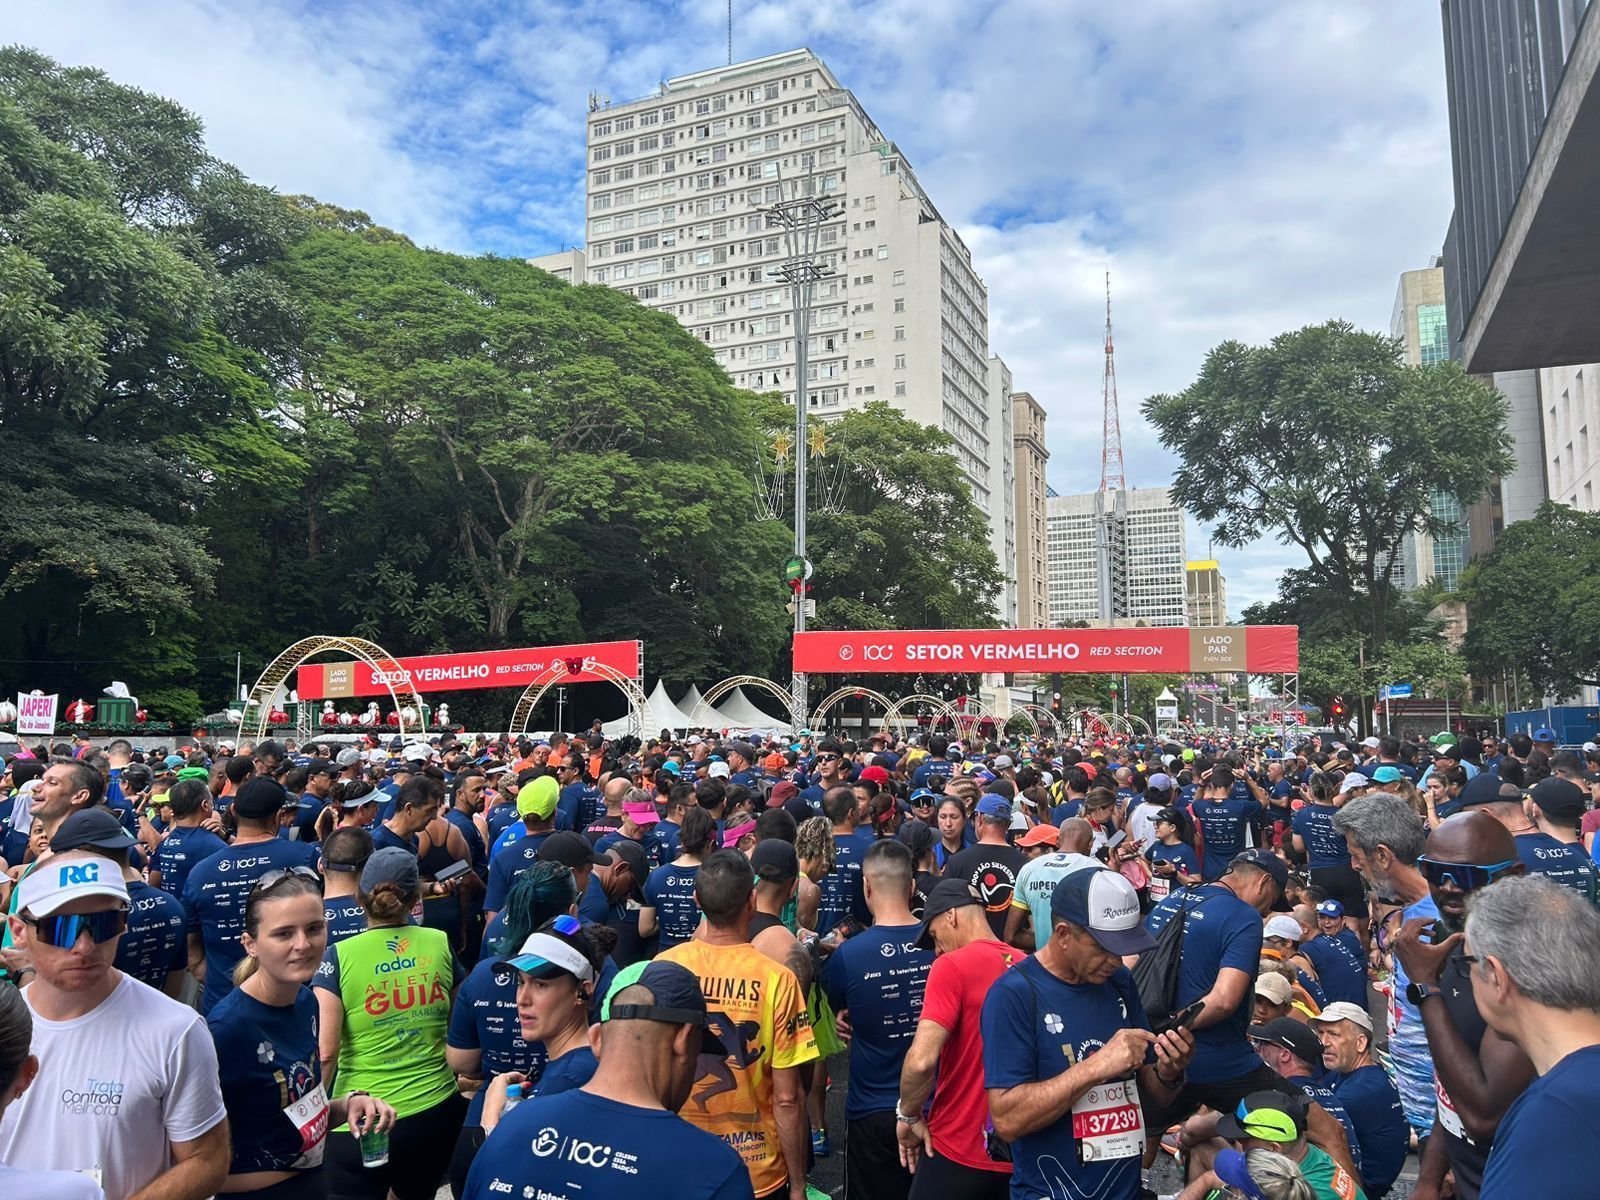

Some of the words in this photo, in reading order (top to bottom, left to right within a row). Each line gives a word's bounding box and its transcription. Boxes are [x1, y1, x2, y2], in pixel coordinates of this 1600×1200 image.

[1203, 636, 1232, 644] LADO
[905, 644, 964, 660] SETOR
[970, 643, 1080, 659] VERMELHO
[1090, 646, 1111, 656] RED
[1114, 646, 1163, 656] SECTION
[1208, 646, 1228, 654] PAR
[330, 669, 347, 677] LADO
[371, 669, 412, 685] SETOR
[416, 664, 490, 681] VERMELHO
[495, 665, 510, 674] RED
[512, 663, 544, 673] SECTION
[20, 697, 53, 717] JAPERI
[365, 971, 441, 994] ATLETA
[364, 981, 446, 1016] GUIA
[87, 1078, 125, 1094] Trata
[61, 1089, 123, 1105] Controla
[62, 1102, 120, 1116] Melhora
[1089, 1109, 1137, 1133] 37239
[489, 1177, 514, 1193] asics
